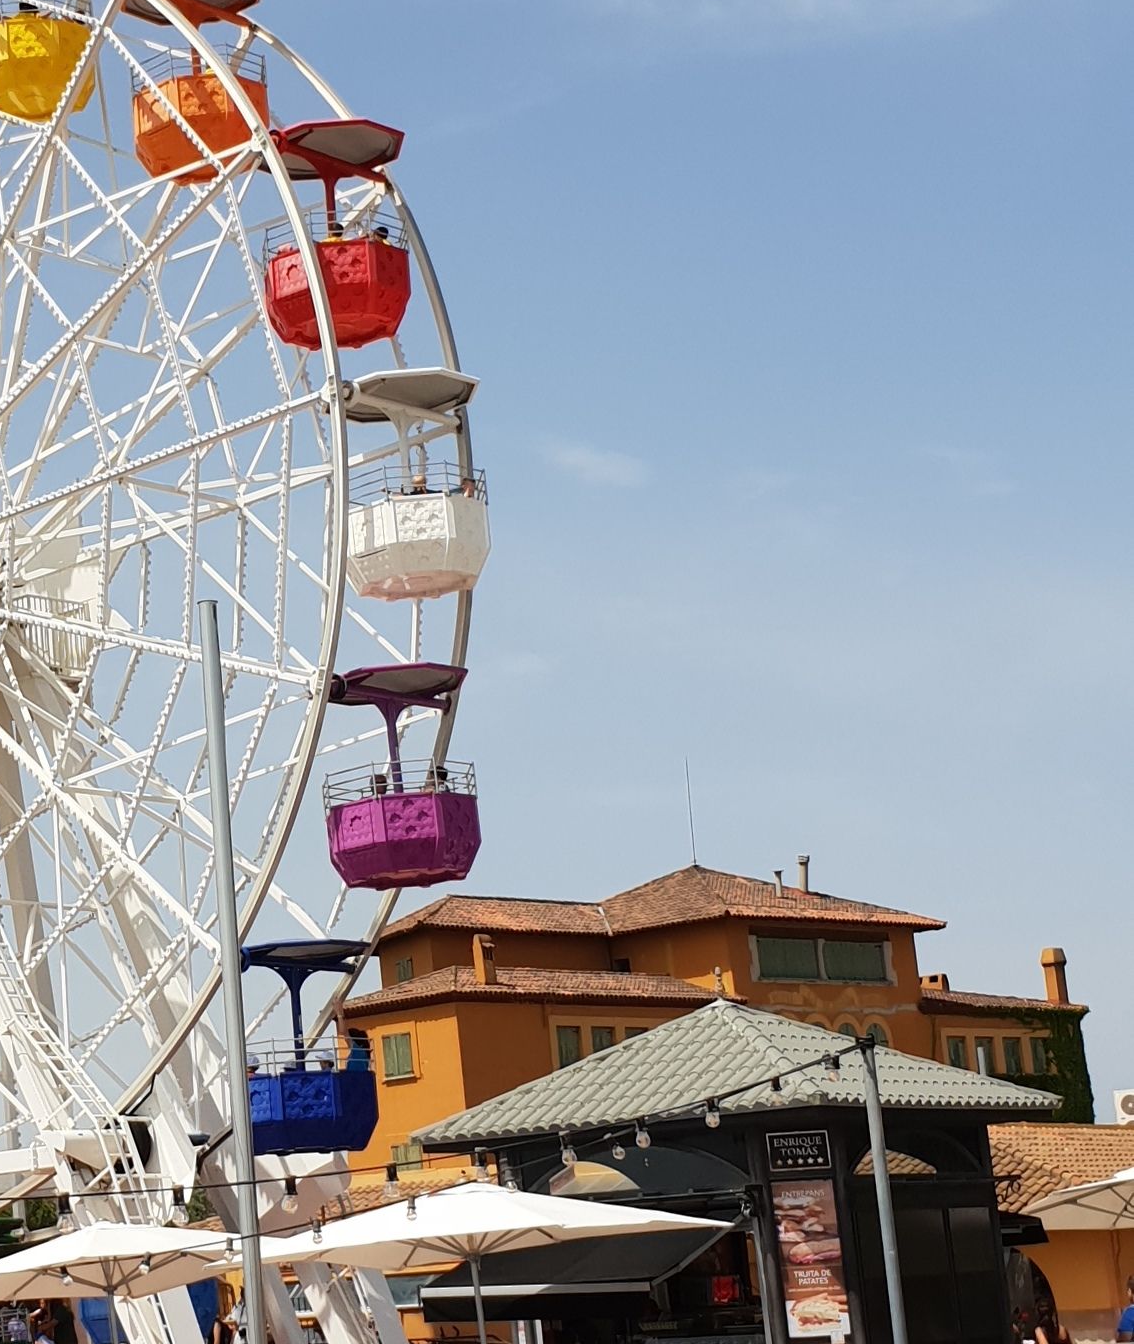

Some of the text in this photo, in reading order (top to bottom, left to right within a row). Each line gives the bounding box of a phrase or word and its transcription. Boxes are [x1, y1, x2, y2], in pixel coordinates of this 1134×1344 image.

[773, 1136, 822, 1147] ENRIQUE
[794, 1270, 820, 1278] TRUITA
[798, 1277, 828, 1285] PATATES
